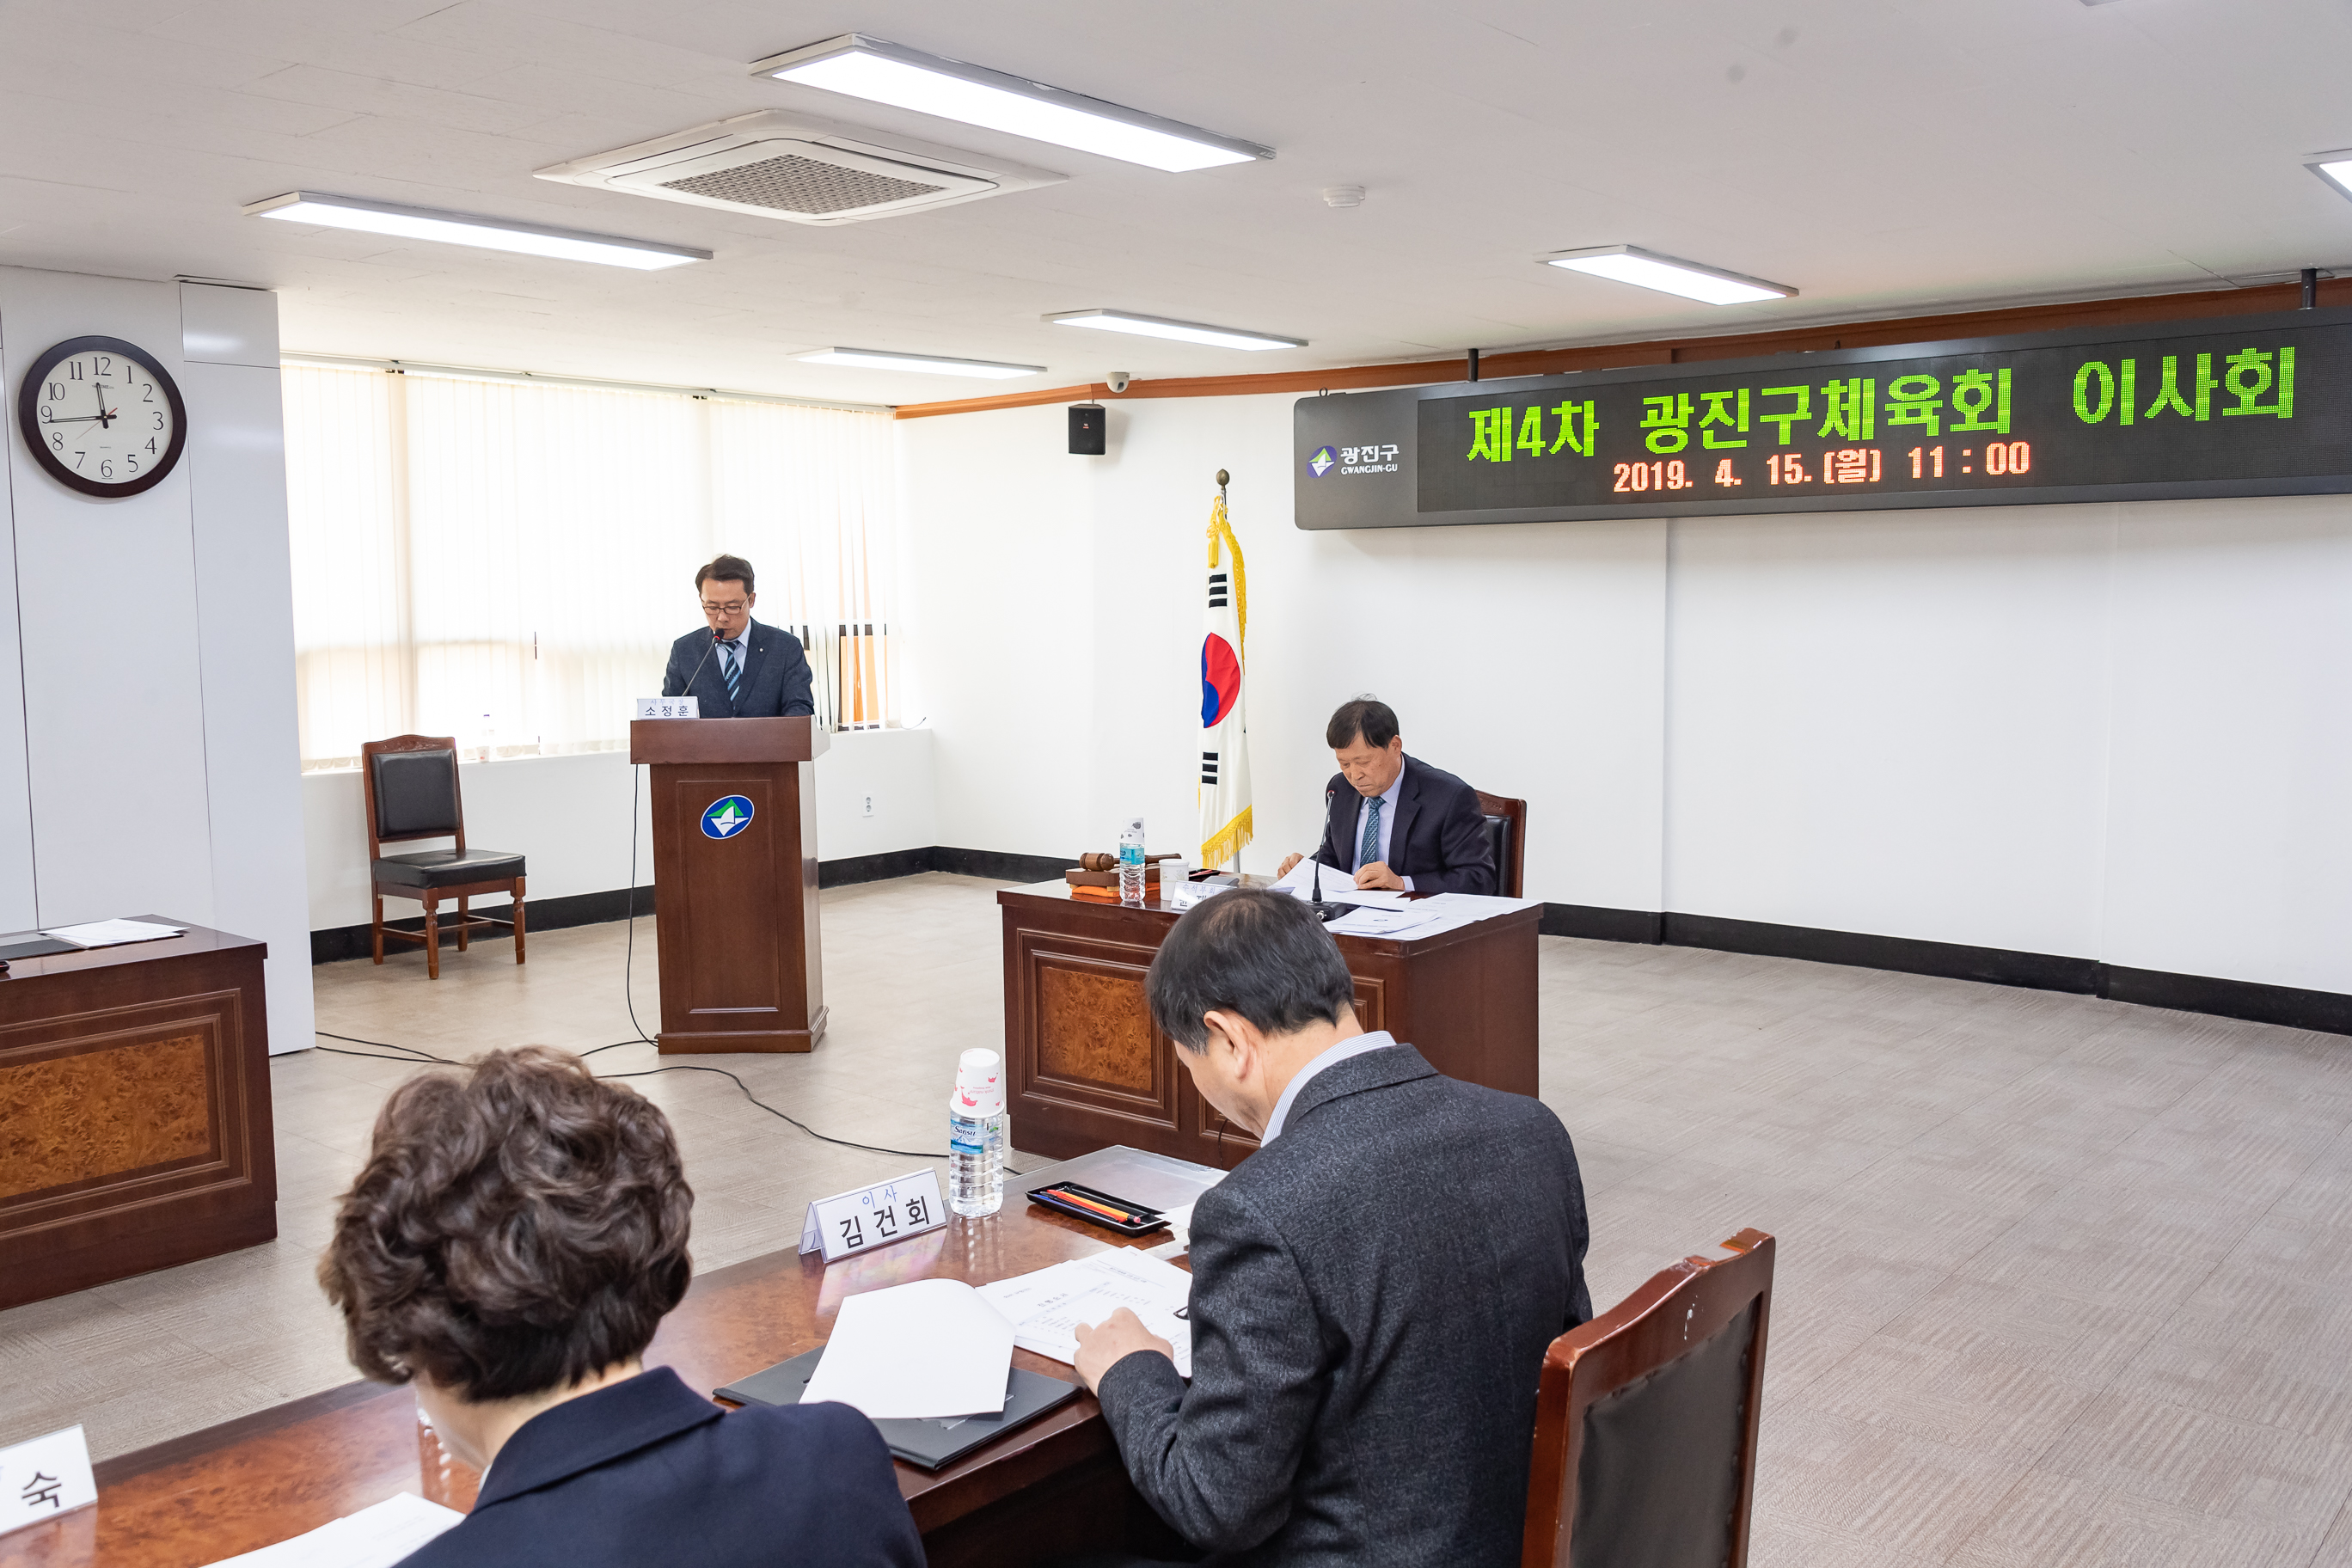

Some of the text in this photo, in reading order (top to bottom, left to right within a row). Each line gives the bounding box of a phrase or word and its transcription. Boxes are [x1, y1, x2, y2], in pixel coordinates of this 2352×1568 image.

[69, 361, 84, 380] 11
[94, 357, 112, 376] 12
[126, 365, 133, 384] 1
[48, 382, 65, 401] 10
[143, 383, 154, 402] 2
[1467, 346, 2295, 463] 제4차 광진구체육회 이사회
[40, 405, 52, 424] 9
[152, 411, 164, 430] 3
[52, 432, 64, 450] 8
[144, 436, 157, 455] 4
[75, 451, 86, 469] 7
[127, 454, 138, 473] 5
[1340, 444, 1400, 465] 광진구
[101, 459, 113, 477] 6
[1340, 463, 1398, 475] GWANGJIN-GU
[1614, 459, 1694, 493] 2019.
[1715, 458, 1742, 487] 4.
[645, 705, 689, 717] 소정훈
